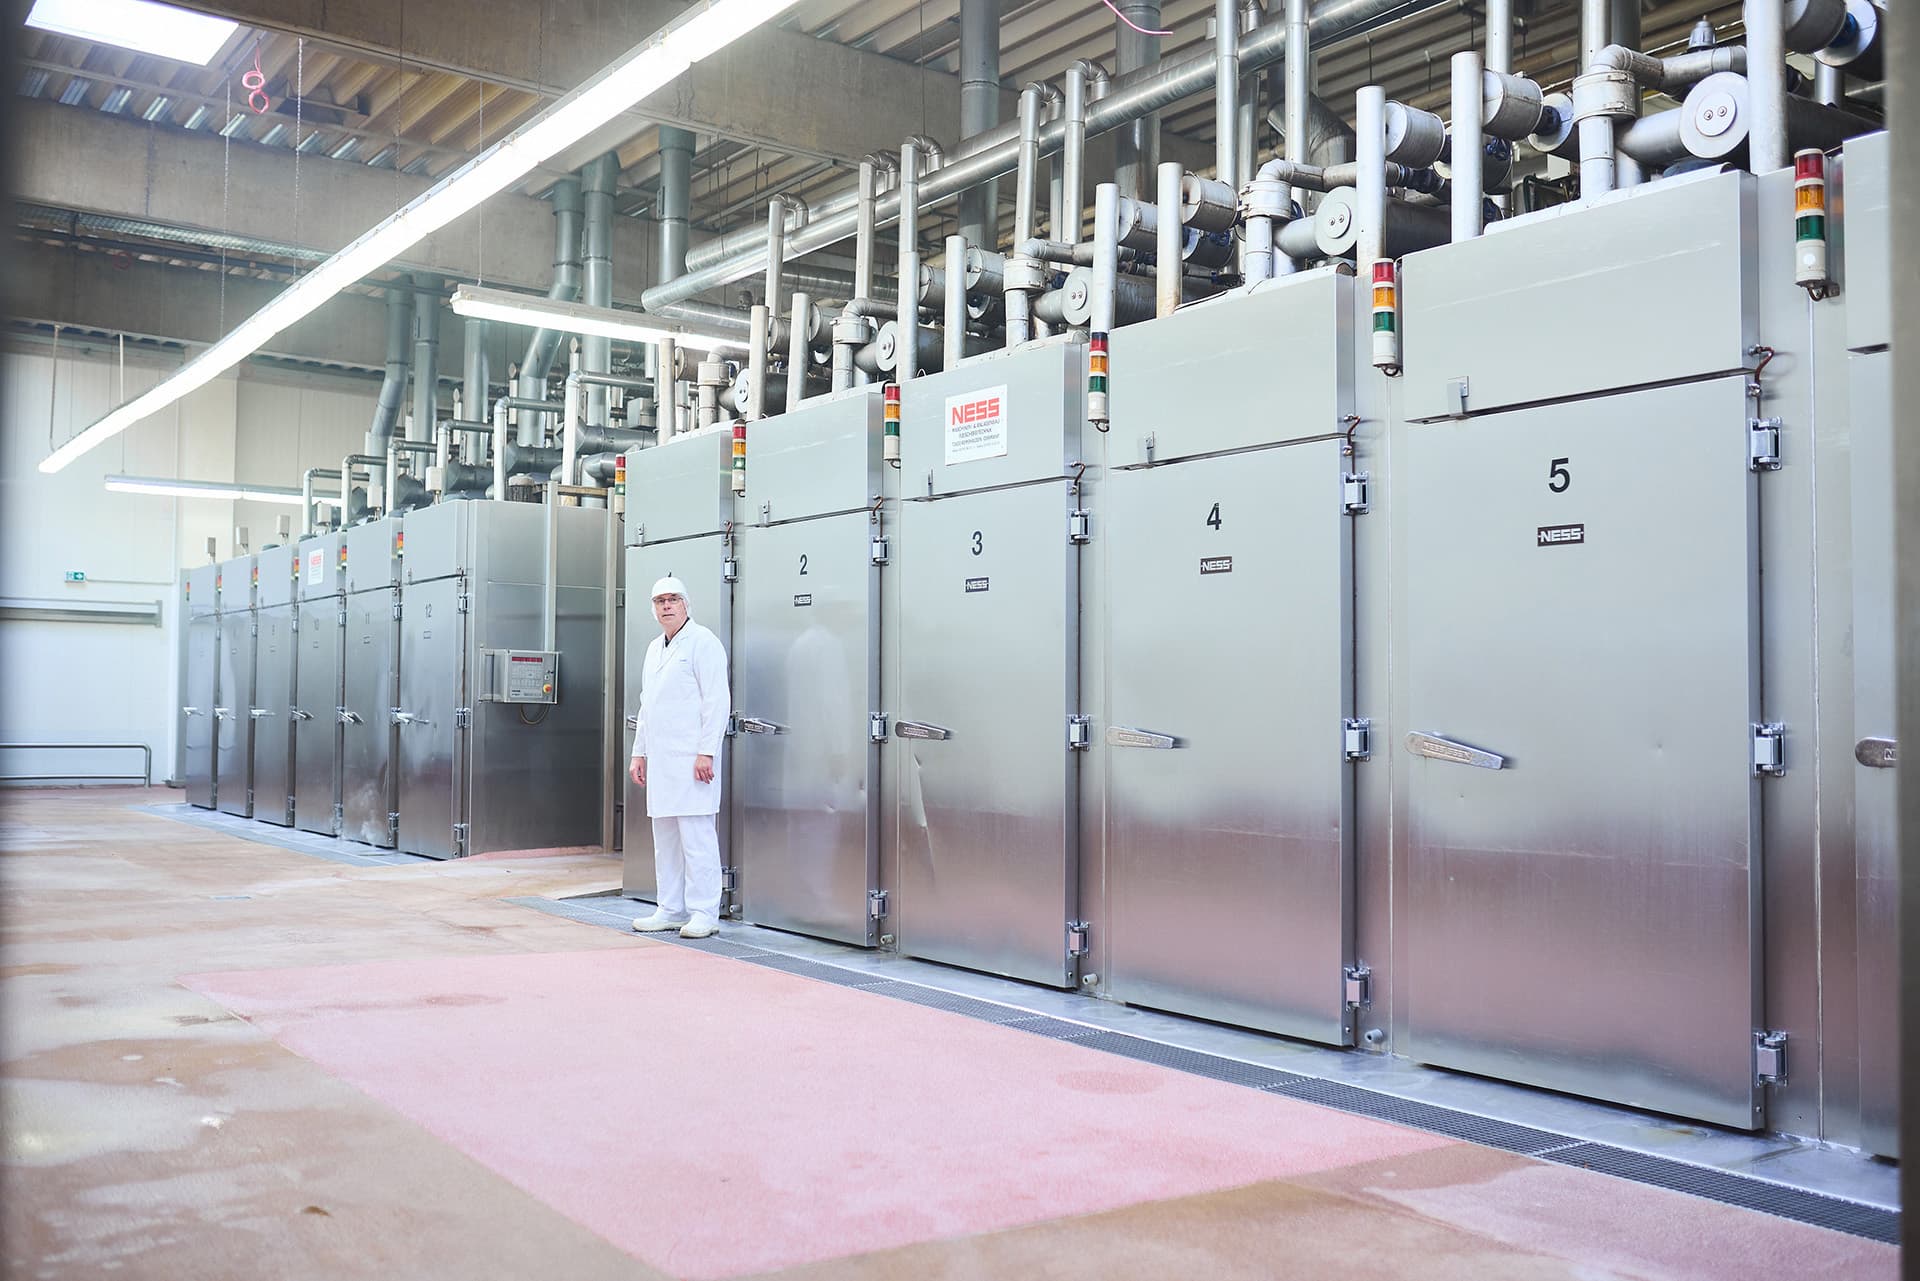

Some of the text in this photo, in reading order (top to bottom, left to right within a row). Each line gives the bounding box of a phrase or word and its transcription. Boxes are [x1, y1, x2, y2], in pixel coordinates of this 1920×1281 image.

[952, 397, 1000, 425] NESS
[1548, 457, 1571, 493] 5
[1206, 502, 1222, 531] 4
[971, 530, 983, 556] 3
[1539, 527, 1582, 543] NESS
[799, 554, 808, 576] 2
[1201, 559, 1230, 572] NESS
